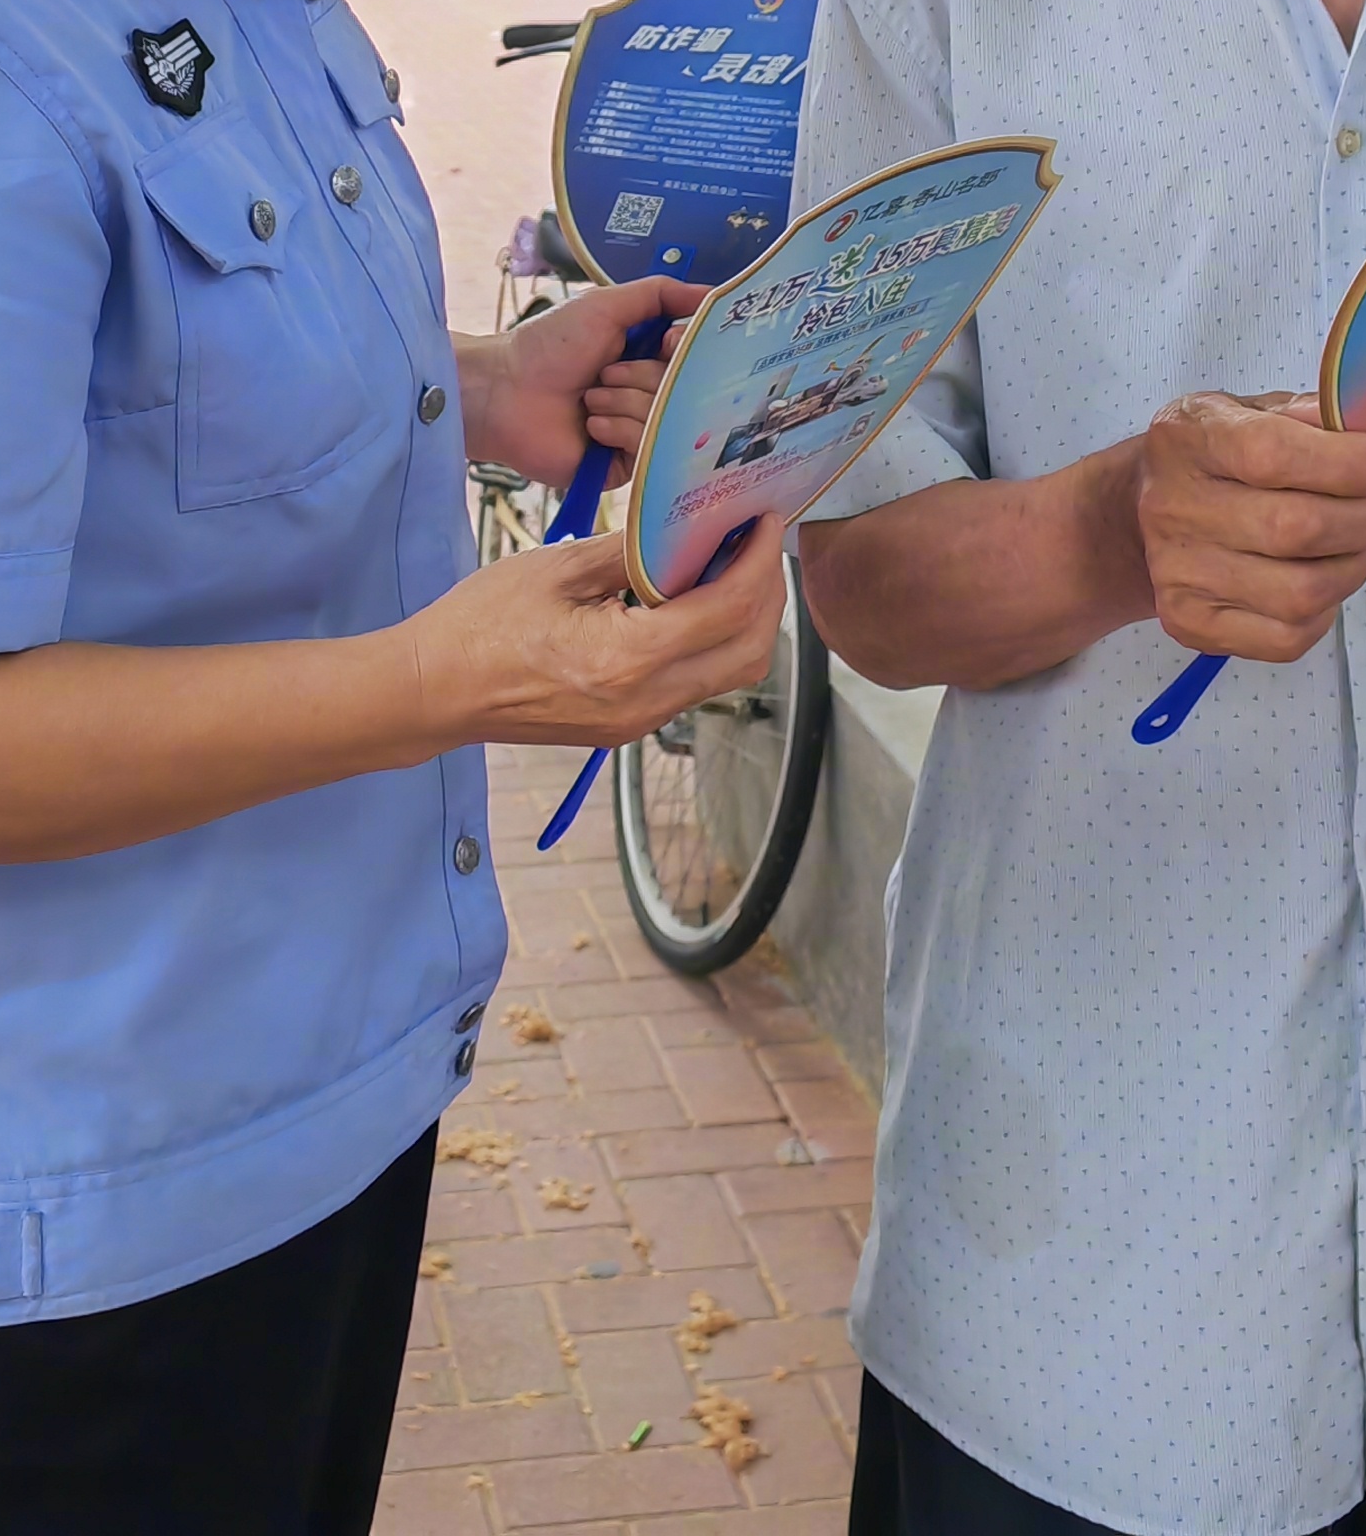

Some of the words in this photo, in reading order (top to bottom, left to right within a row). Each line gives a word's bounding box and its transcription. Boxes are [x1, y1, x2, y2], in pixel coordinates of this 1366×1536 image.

[624, 25, 733, 53] 防诈骗
[791, 274, 916, 344] 拎包入住
[672, 496, 706, 518] 7828
